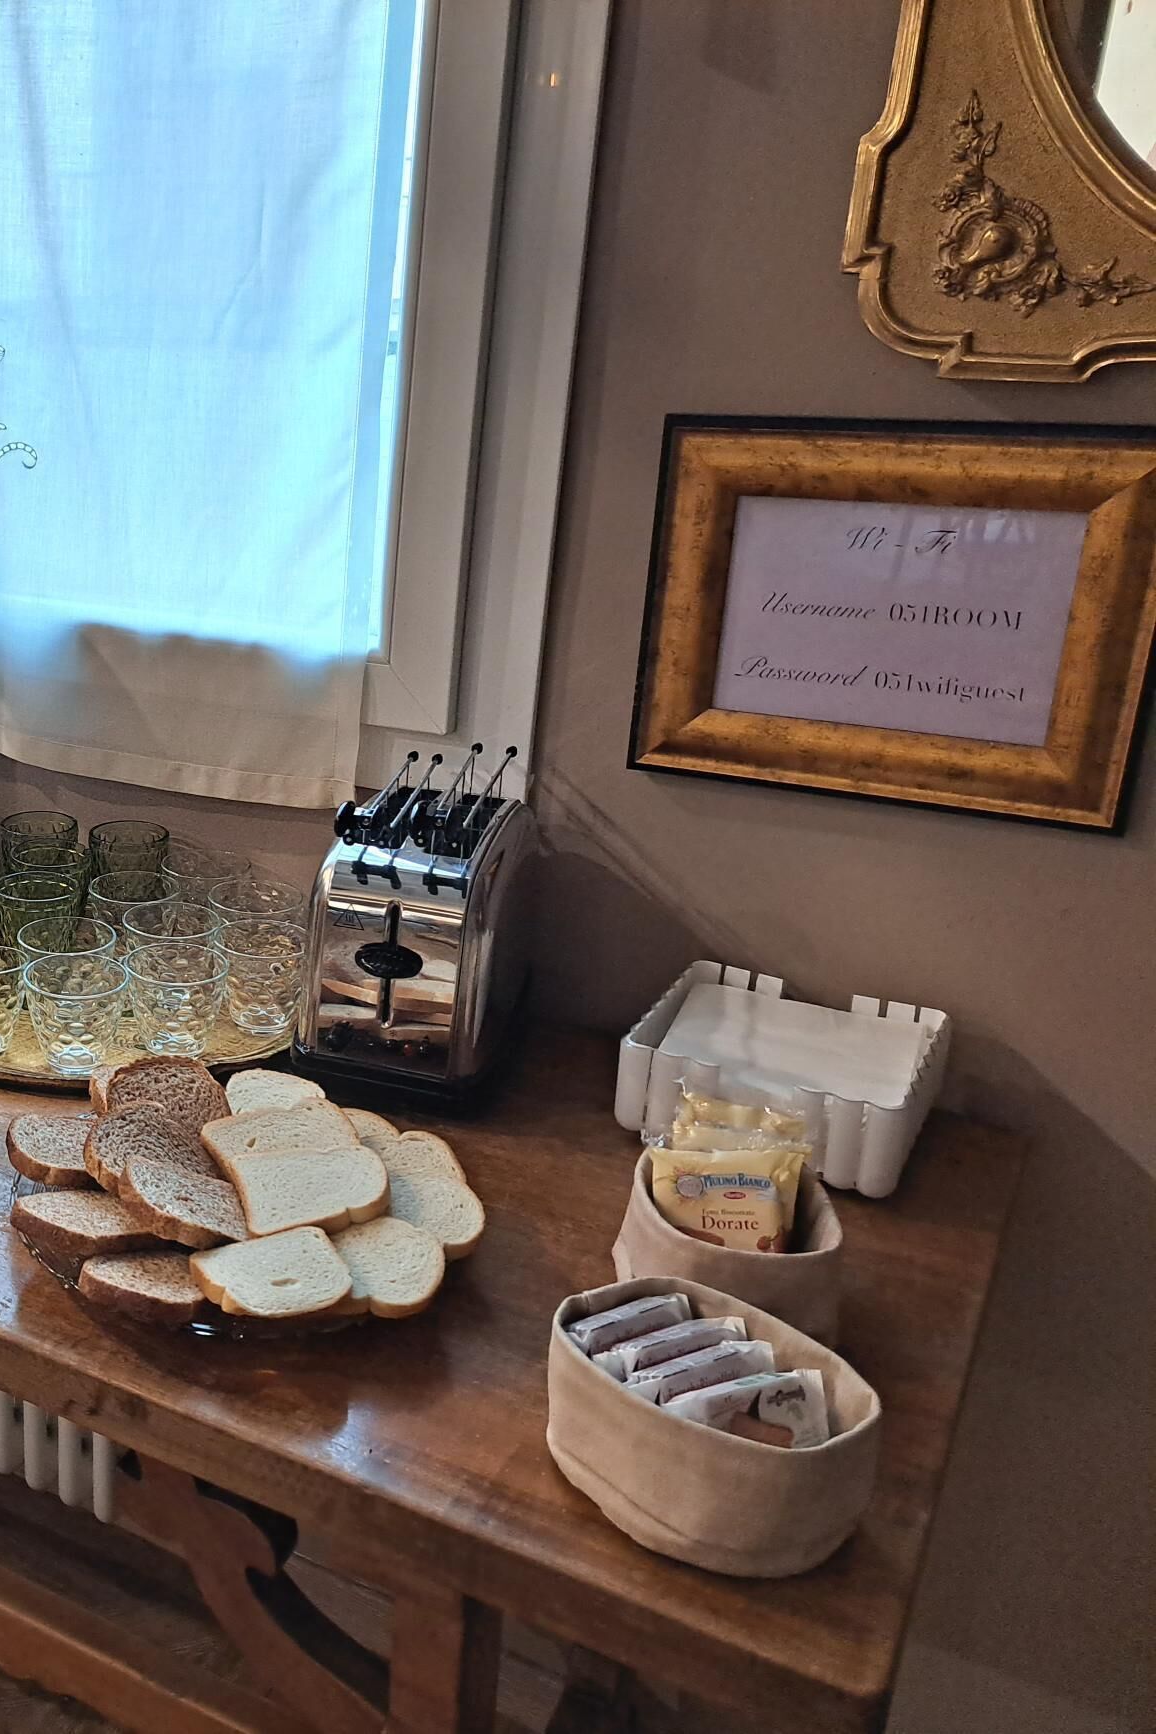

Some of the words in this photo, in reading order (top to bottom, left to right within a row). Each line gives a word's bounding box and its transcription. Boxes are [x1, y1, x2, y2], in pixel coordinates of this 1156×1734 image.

[846, 526, 889, 550] Wi
[914, 529, 958, 554] Fi
[761, 592, 877, 620] Username
[889, 602, 1022, 630] 051ROOM
[733, 655, 869, 687] Password
[874, 671, 1025, 702] 051wifiguest
[703, 1174, 737, 1188] MULINO
[738, 1172, 771, 1189] BIANCO
[701, 1215, 760, 1231] Dorate
